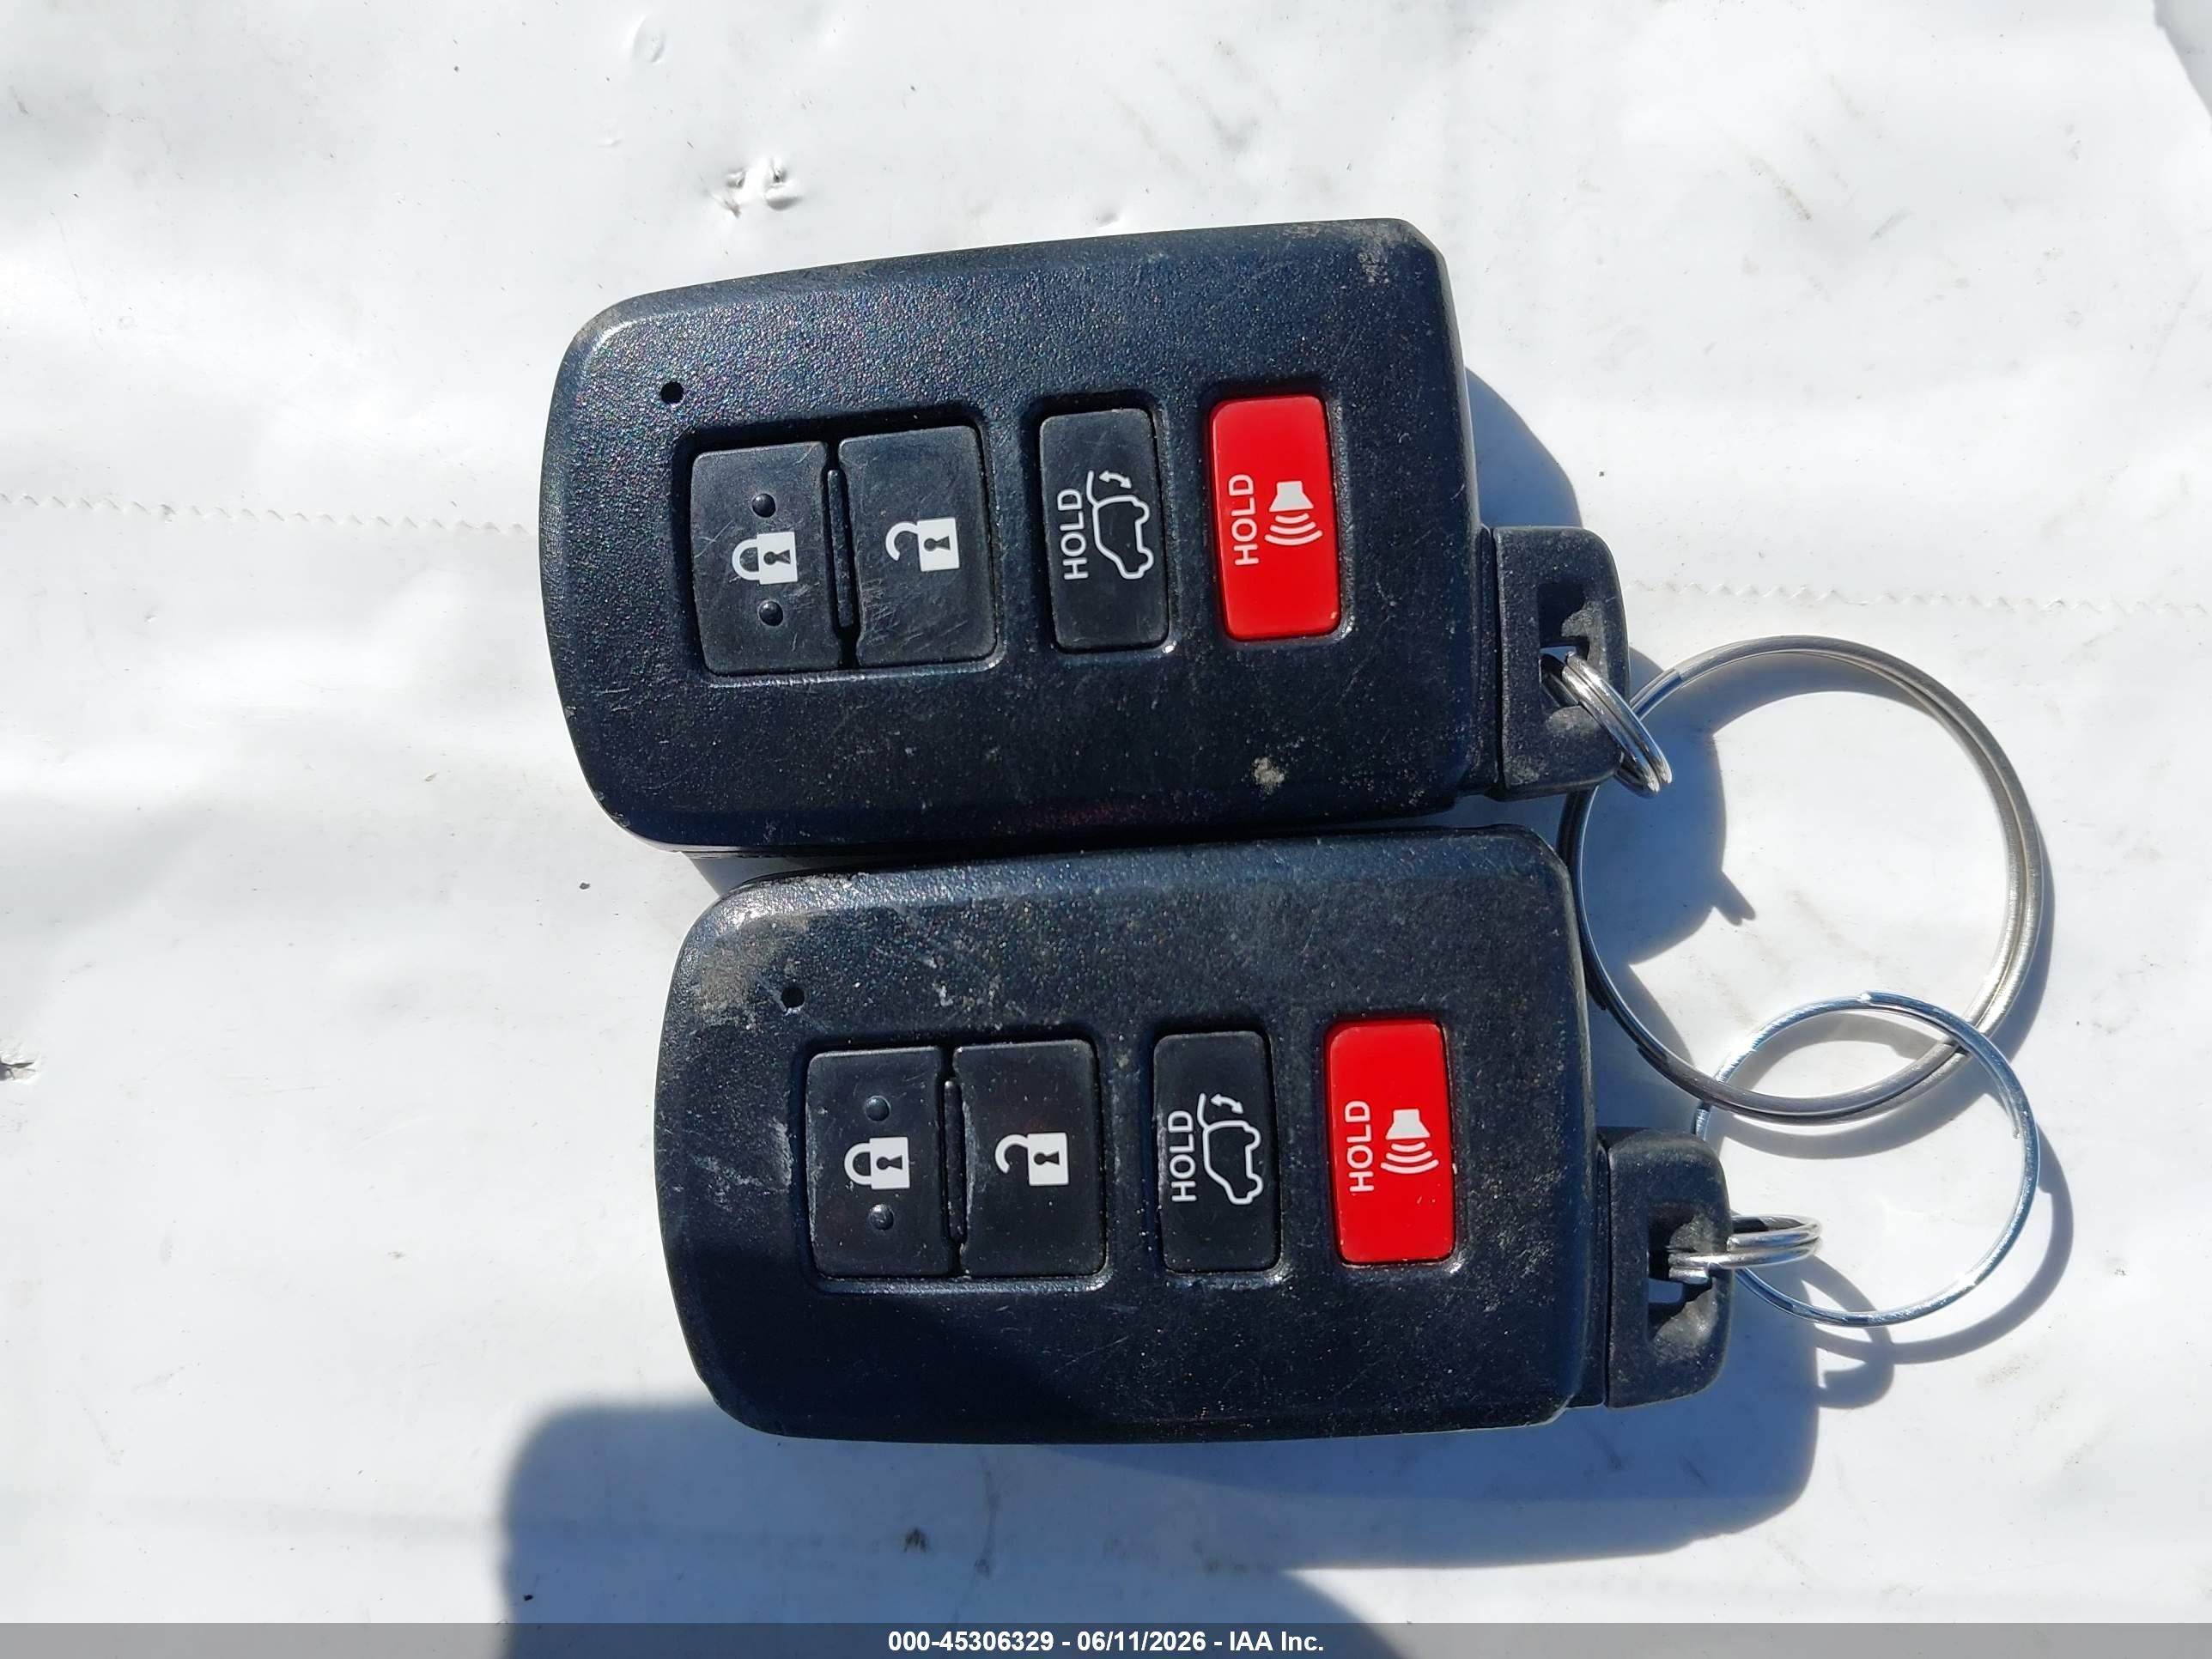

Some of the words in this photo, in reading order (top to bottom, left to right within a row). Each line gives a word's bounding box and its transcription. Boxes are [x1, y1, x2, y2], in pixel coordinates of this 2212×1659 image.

[1057, 489, 1089, 580] HOLD
[1228, 474, 1260, 566] HOLD
[1167, 1110, 1197, 1202] HOLD
[1345, 1101, 1375, 1193] HOLD
